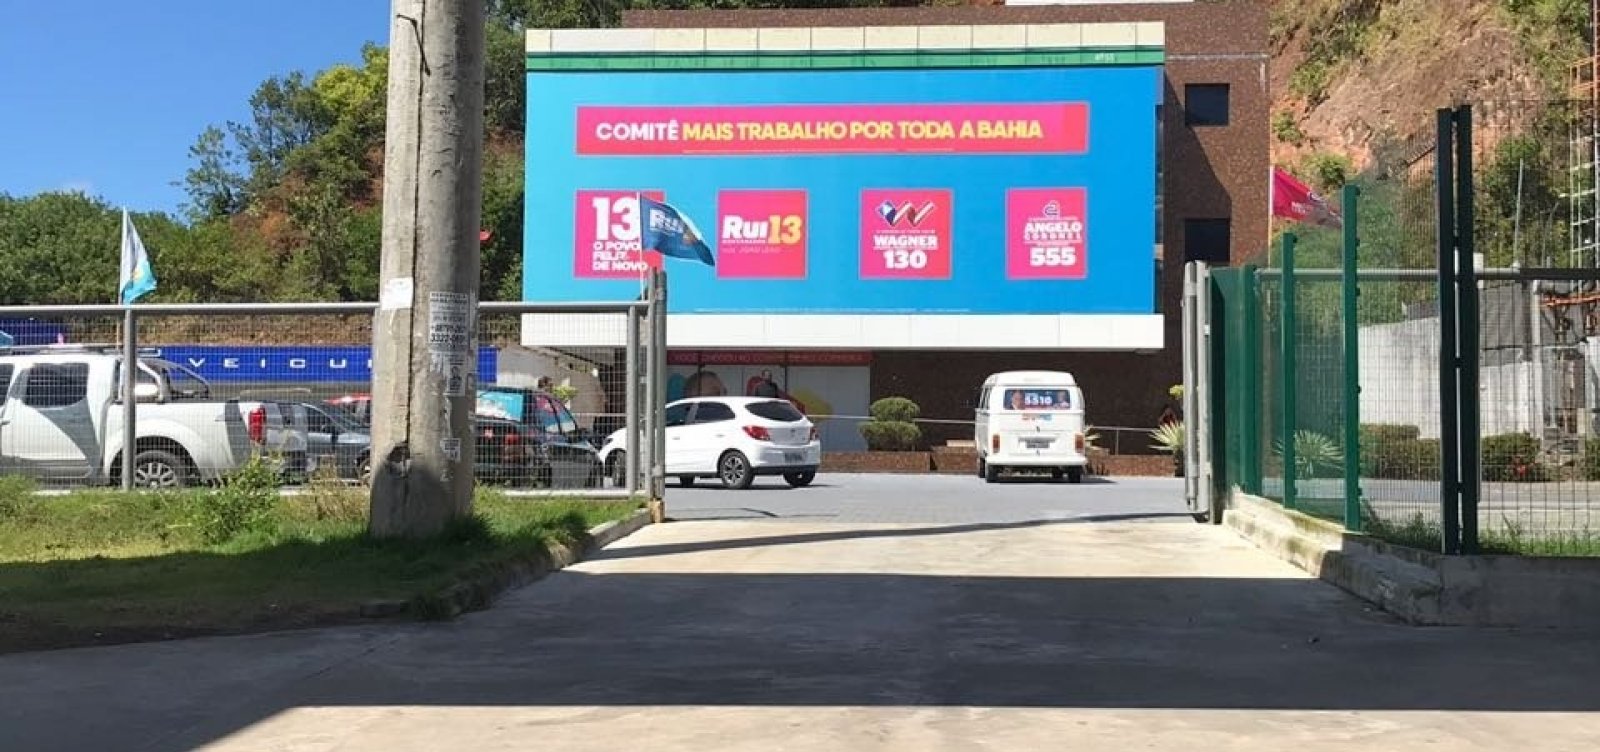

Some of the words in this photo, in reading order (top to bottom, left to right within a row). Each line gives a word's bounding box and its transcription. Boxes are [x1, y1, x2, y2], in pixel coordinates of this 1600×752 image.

[596, 118, 679, 141] COMITÊ
[683, 123, 734, 141] MAIS
[737, 121, 847, 140] TRABALHO
[850, 122, 894, 139] POR
[899, 121, 955, 139] TODA
[959, 121, 976, 138] A
[978, 120, 1043, 138] BAHIA
[592, 196, 640, 241] 13
[1025, 221, 1082, 233] ANGELO
[593, 241, 604, 250] O
[605, 240, 640, 250] POVO
[873, 234, 938, 246] WAGNER
[883, 250, 927, 269] 130
[1030, 247, 1077, 266] 555
[592, 261, 610, 271] DE
[612, 261, 648, 271] NOVO
[188, 356, 373, 369] VEICU
